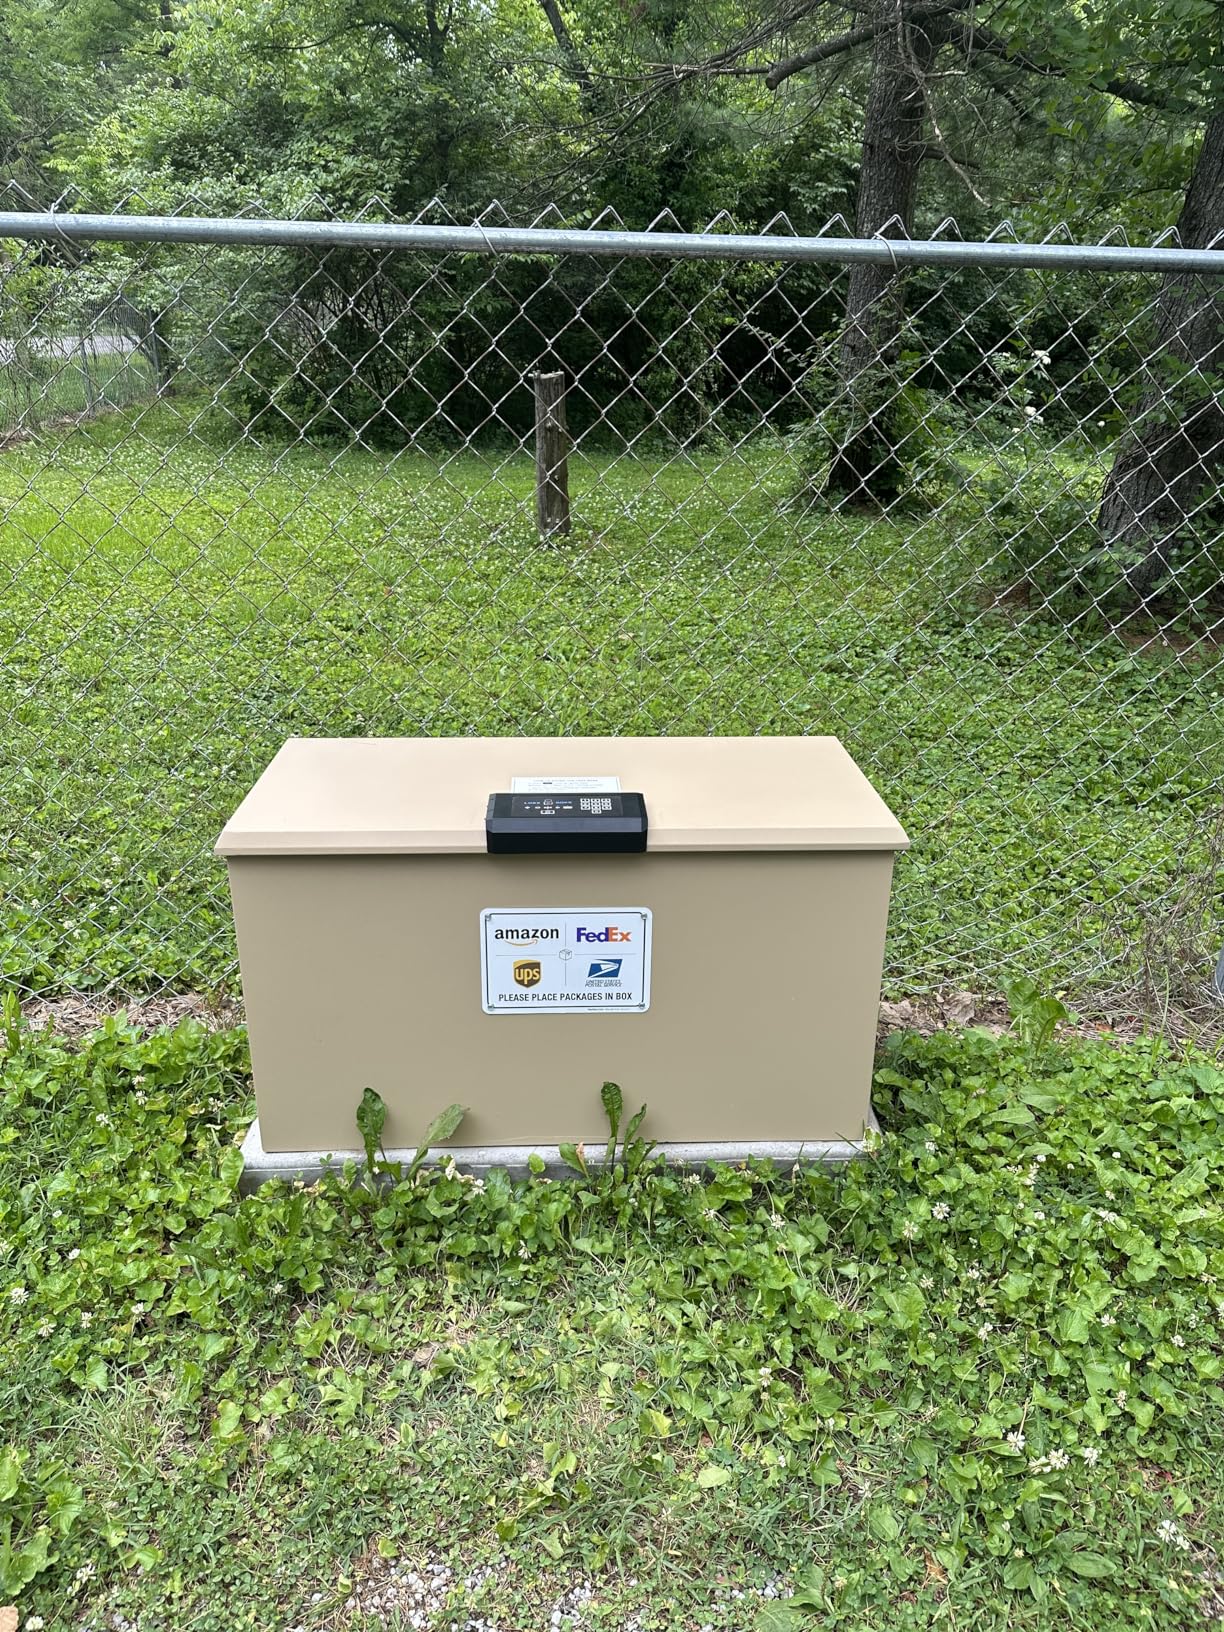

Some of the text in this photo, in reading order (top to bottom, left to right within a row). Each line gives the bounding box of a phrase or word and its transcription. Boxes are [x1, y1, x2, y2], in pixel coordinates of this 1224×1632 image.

[495, 928, 560, 940] amazon
[576, 927, 632, 942] FedEx
[514, 967, 540, 985] ups
[498, 992, 632, 1002] PLEASE PLACE PACKAGES IN BOX
